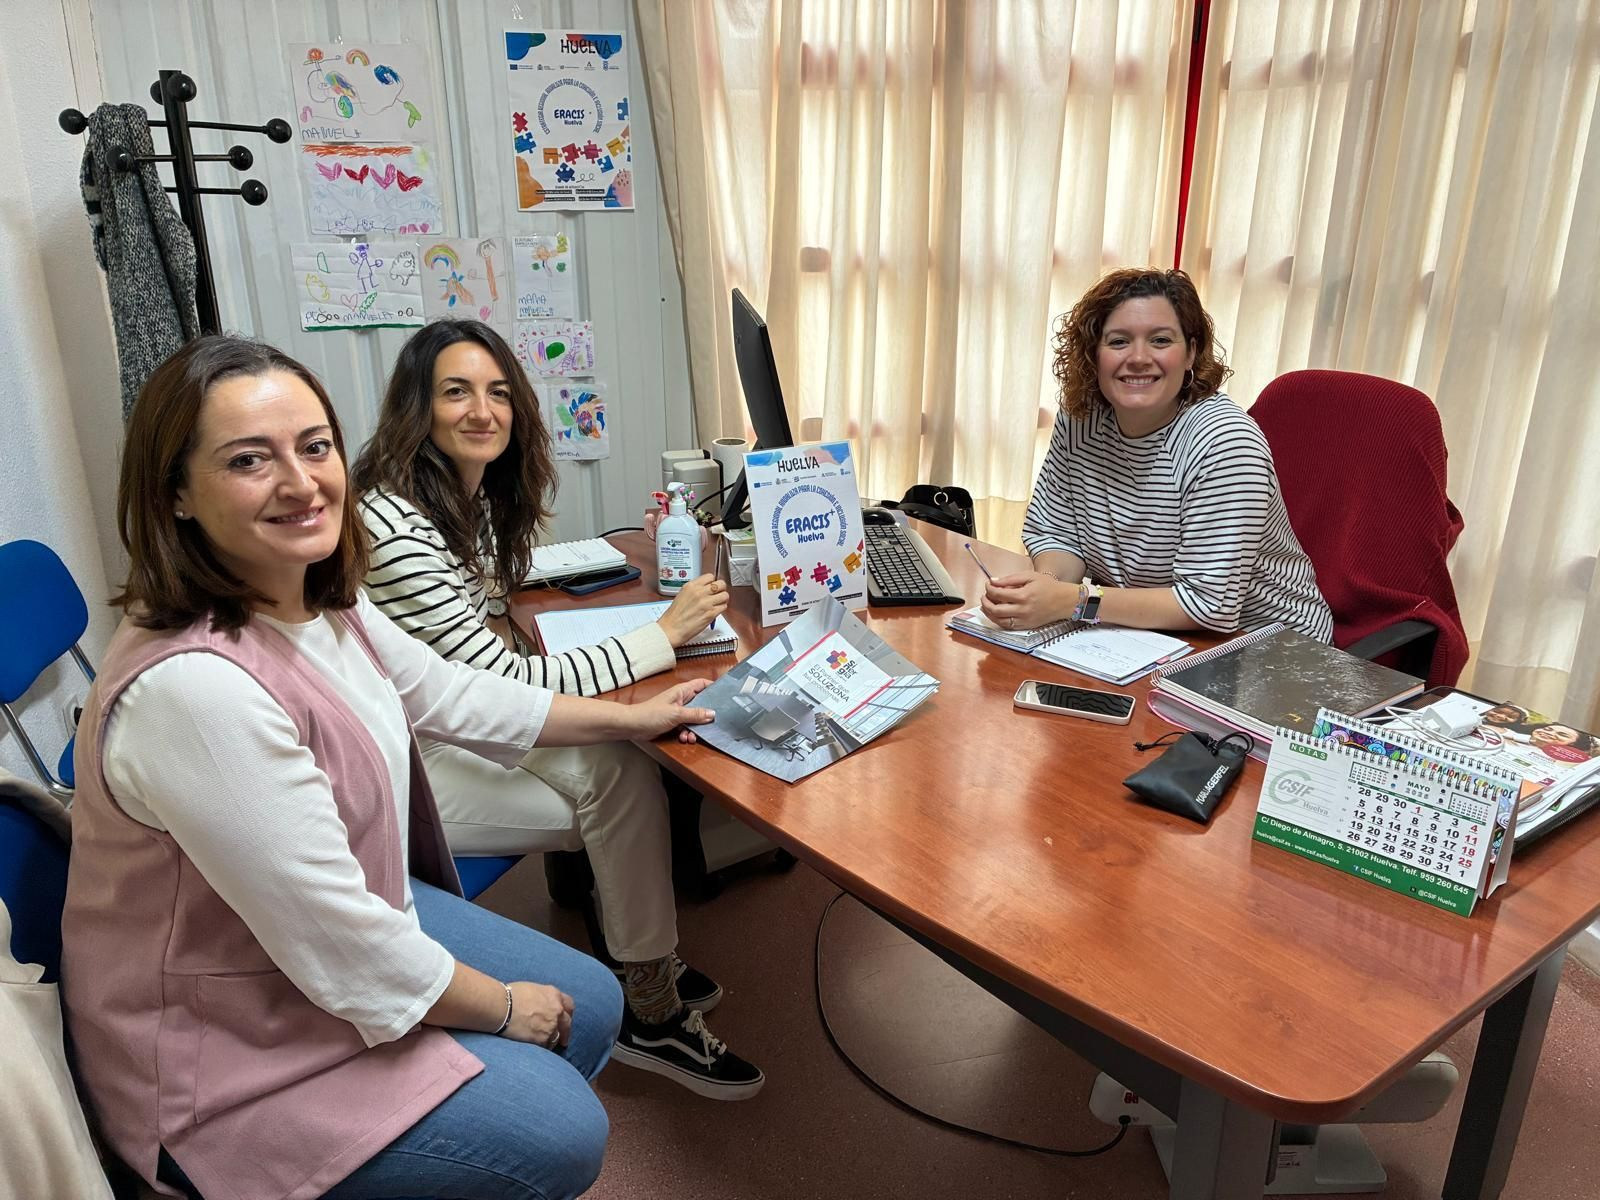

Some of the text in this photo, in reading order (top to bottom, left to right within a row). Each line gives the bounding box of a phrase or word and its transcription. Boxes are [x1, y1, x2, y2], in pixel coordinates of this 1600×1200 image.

[798, 485, 810, 494] PARA
[798, 532, 825, 544] Huelva
[808, 668, 849, 702] SOLUZIONA
[1290, 743, 1326, 760] NOTAS
[1278, 779, 1315, 797] CSIF
[1407, 781, 1431, 793] MAYO
[1304, 800, 1328, 816] Huelva
[1358, 787, 1371, 796] 28
[1376, 793, 1389, 803] 29
[1393, 799, 1407, 809] 30
[1452, 818, 1459, 826] 3
[1359, 799, 1365, 807] 5
[1376, 805, 1383, 813] 6
[1412, 817, 1419, 825] 8
[1430, 823, 1437, 831] 9
[1446, 829, 1459, 838] 10
[1465, 835, 1477, 844] 11
[1354, 810, 1475, 856] 12 13 14 15 16 17 18
[1347, 832, 1360, 840] 26
[1364, 837, 1378, 847] 27
[1382, 843, 1395, 853] 28
[1400, 850, 1413, 859] 29
[1418, 856, 1431, 865] 30
[1436, 862, 1450, 872] 31
[1351, 821, 1472, 867] 19 20 21 22 23 24 25
[1270, 819, 1291, 832] Diego
[1302, 832, 1336, 848] Almagro,
[1346, 846, 1369, 859] 21002
[1402, 866, 1418, 877] Telf.
[1420, 872, 1435, 883] 959
[1436, 879, 1452, 889] 260
[1453, 886, 1469, 895] 645
[1360, 868, 1392, 884] CSIF Huelva
[1418, 889, 1456, 907] @CSIF Huelva
